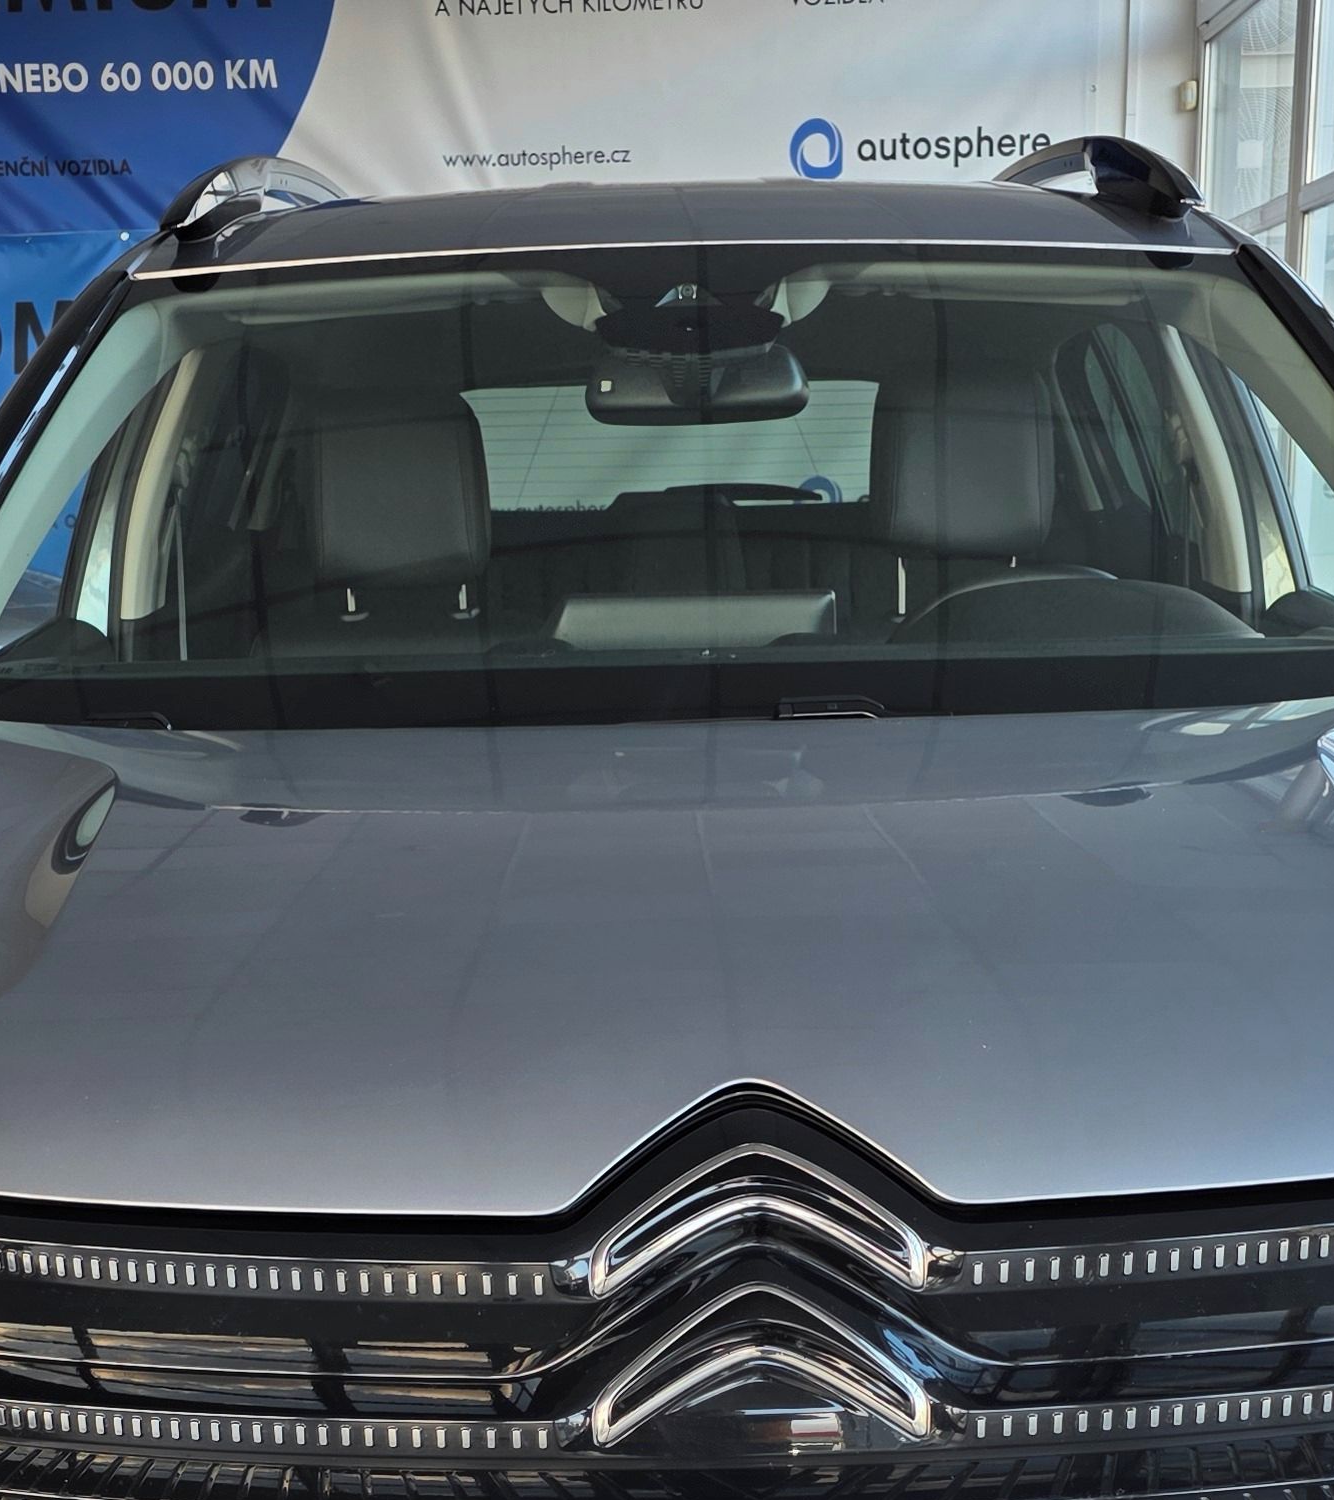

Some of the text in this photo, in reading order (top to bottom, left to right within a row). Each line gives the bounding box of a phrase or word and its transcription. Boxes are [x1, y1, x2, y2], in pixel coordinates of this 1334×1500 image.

[0, 61, 89, 94] NEBO
[100, 60, 143, 93] 60
[151, 60, 215, 92] 000
[225, 58, 279, 91] KM
[442, 145, 633, 172] www.autosphere.cz
[856, 126, 1051, 168] autosphere
[55, 157, 134, 178] VOZIDLA
